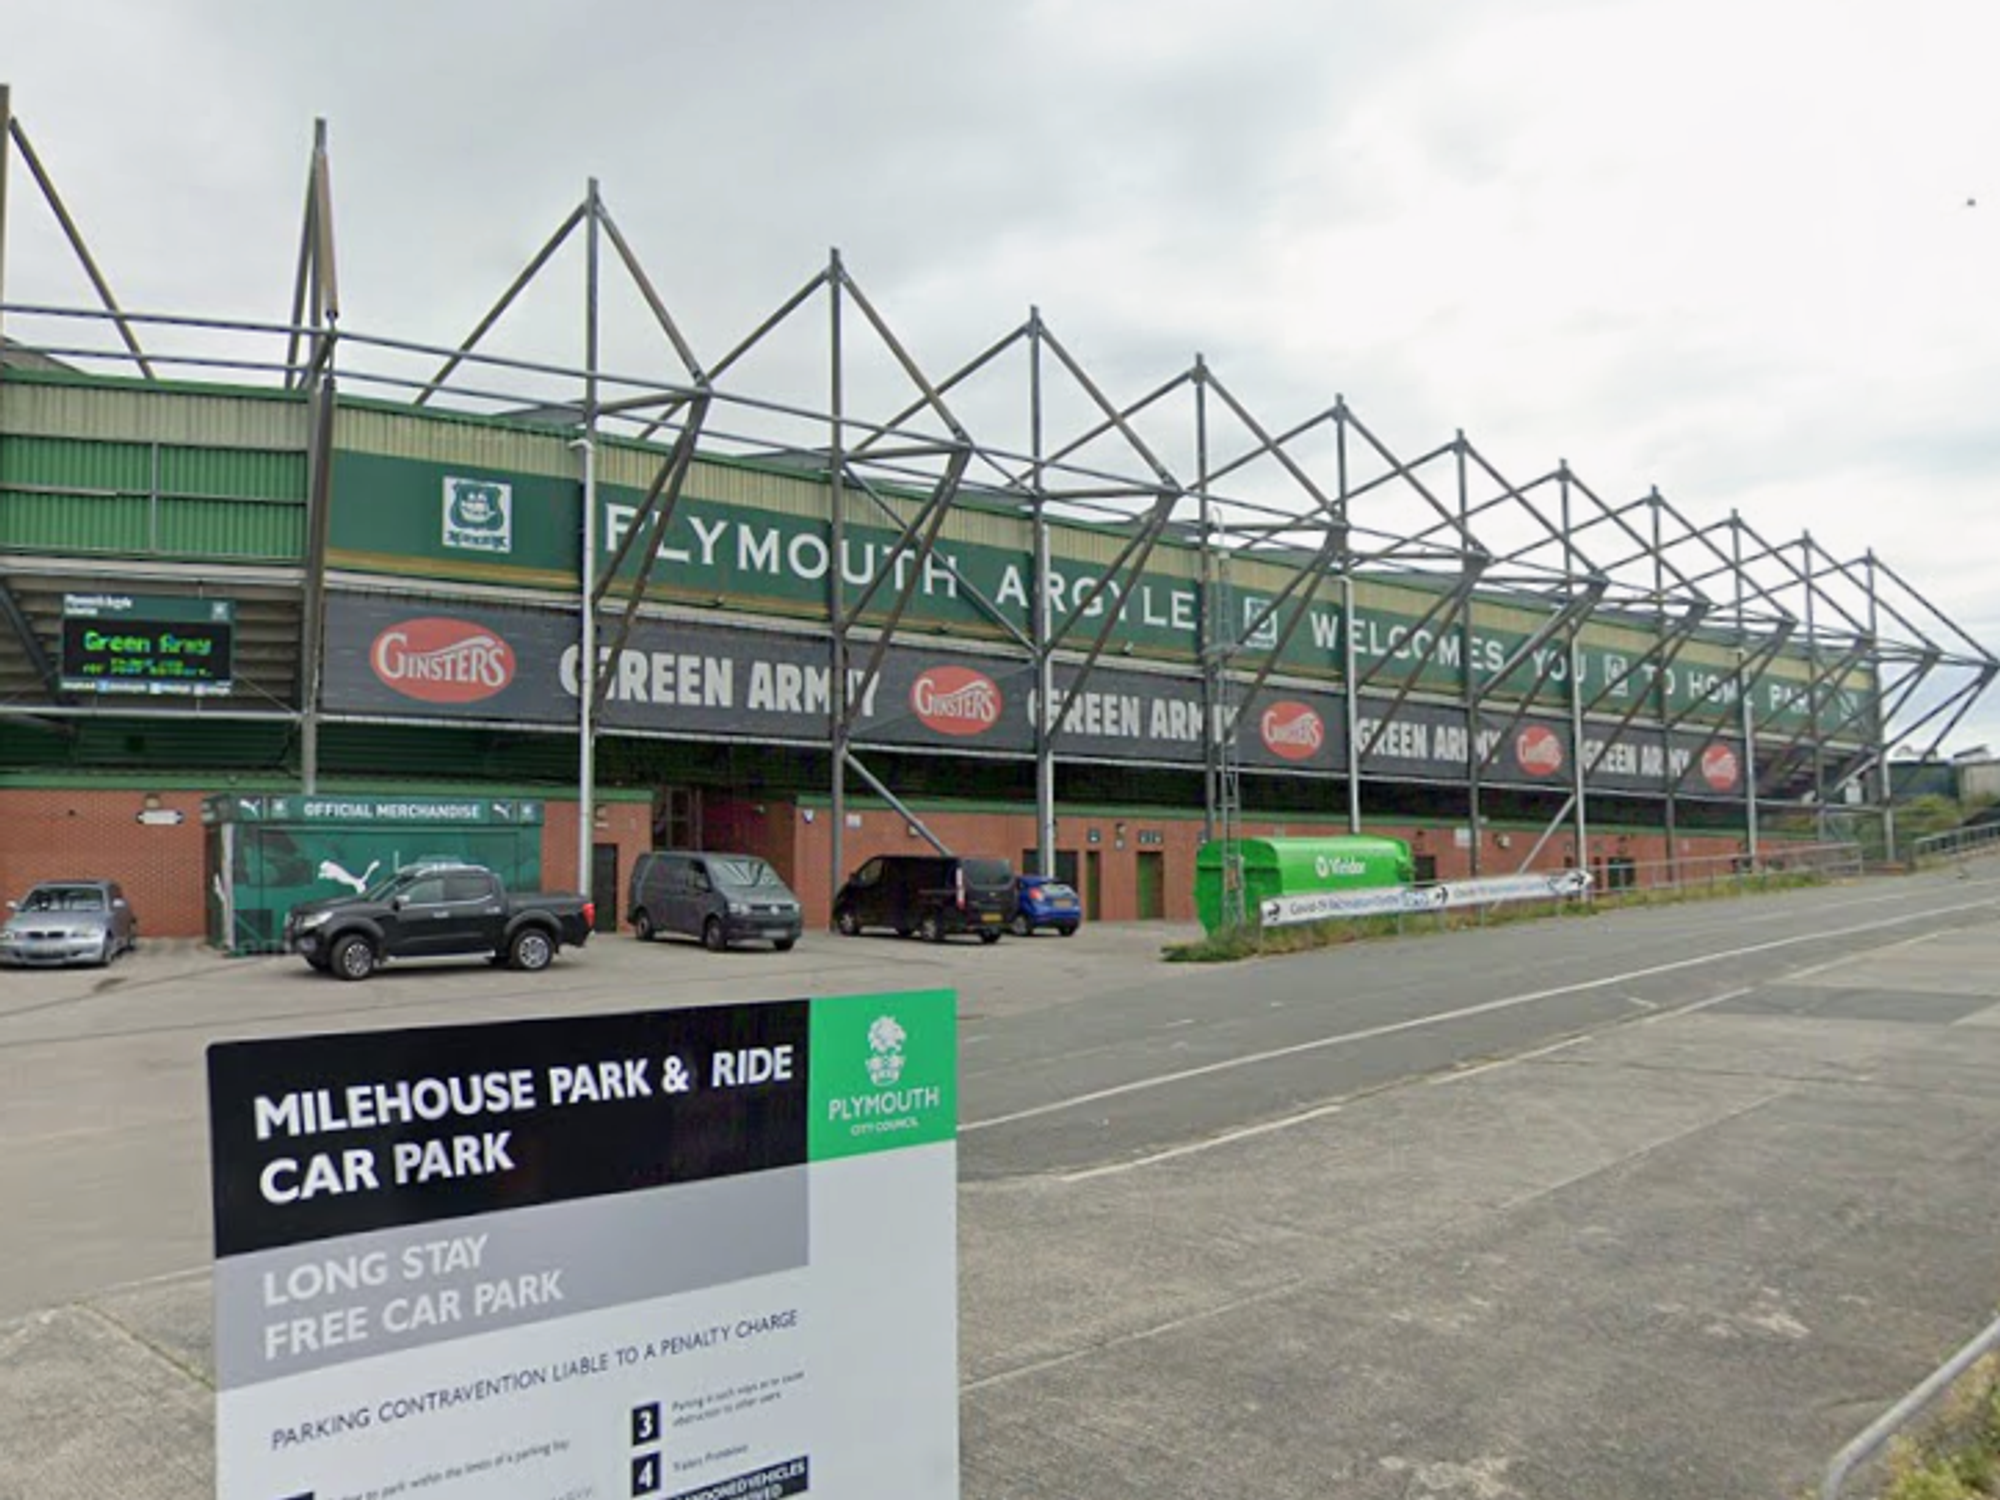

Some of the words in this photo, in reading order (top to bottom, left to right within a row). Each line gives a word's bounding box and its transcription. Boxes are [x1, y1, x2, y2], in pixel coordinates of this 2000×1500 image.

[606, 502, 958, 598] PLYMOUTH
[995, 564, 1198, 632] ARGYLE
[1310, 612, 1504, 670] WELCOMES
[84, 630, 151, 653] Green
[377, 632, 506, 687] GINSTERS
[559, 643, 733, 707] GREEN
[747, 661, 881, 717] ARMY
[1027, 688, 1140, 738] GREEN
[1356, 718, 1428, 759] GREEN
[303, 802, 373, 817] OFFICIAL
[375, 803, 480, 819] MERCHANDISE
[254, 1069, 535, 1140] MILEHOUSE
[549, 1058, 652, 1105] PARK
[662, 1054, 690, 1093] &
[711, 1044, 794, 1088] RIDE
[828, 1086, 940, 1121] PLYMOUTH
[259, 1149, 380, 1206] CAR
[393, 1130, 515, 1185] PARK
[263, 1251, 389, 1309] LONG
[402, 1232, 489, 1280] STAY
[264, 1305, 369, 1362] FREE
[382, 1289, 462, 1334] CAR
[474, 1268, 565, 1317] PARK
[270, 1407, 371, 1450] PARKING
[377, 1367, 546, 1423] CONTRAVENTION
[552, 1353, 610, 1383] LIABLE
[615, 1346, 639, 1367] TO
[643, 1343, 656, 1361] A
[660, 1324, 730, 1357] PENALTY
[735, 1309, 798, 1339] CHARGE
[638, 1411, 653, 1438] 3
[638, 1460, 653, 1488] 4
